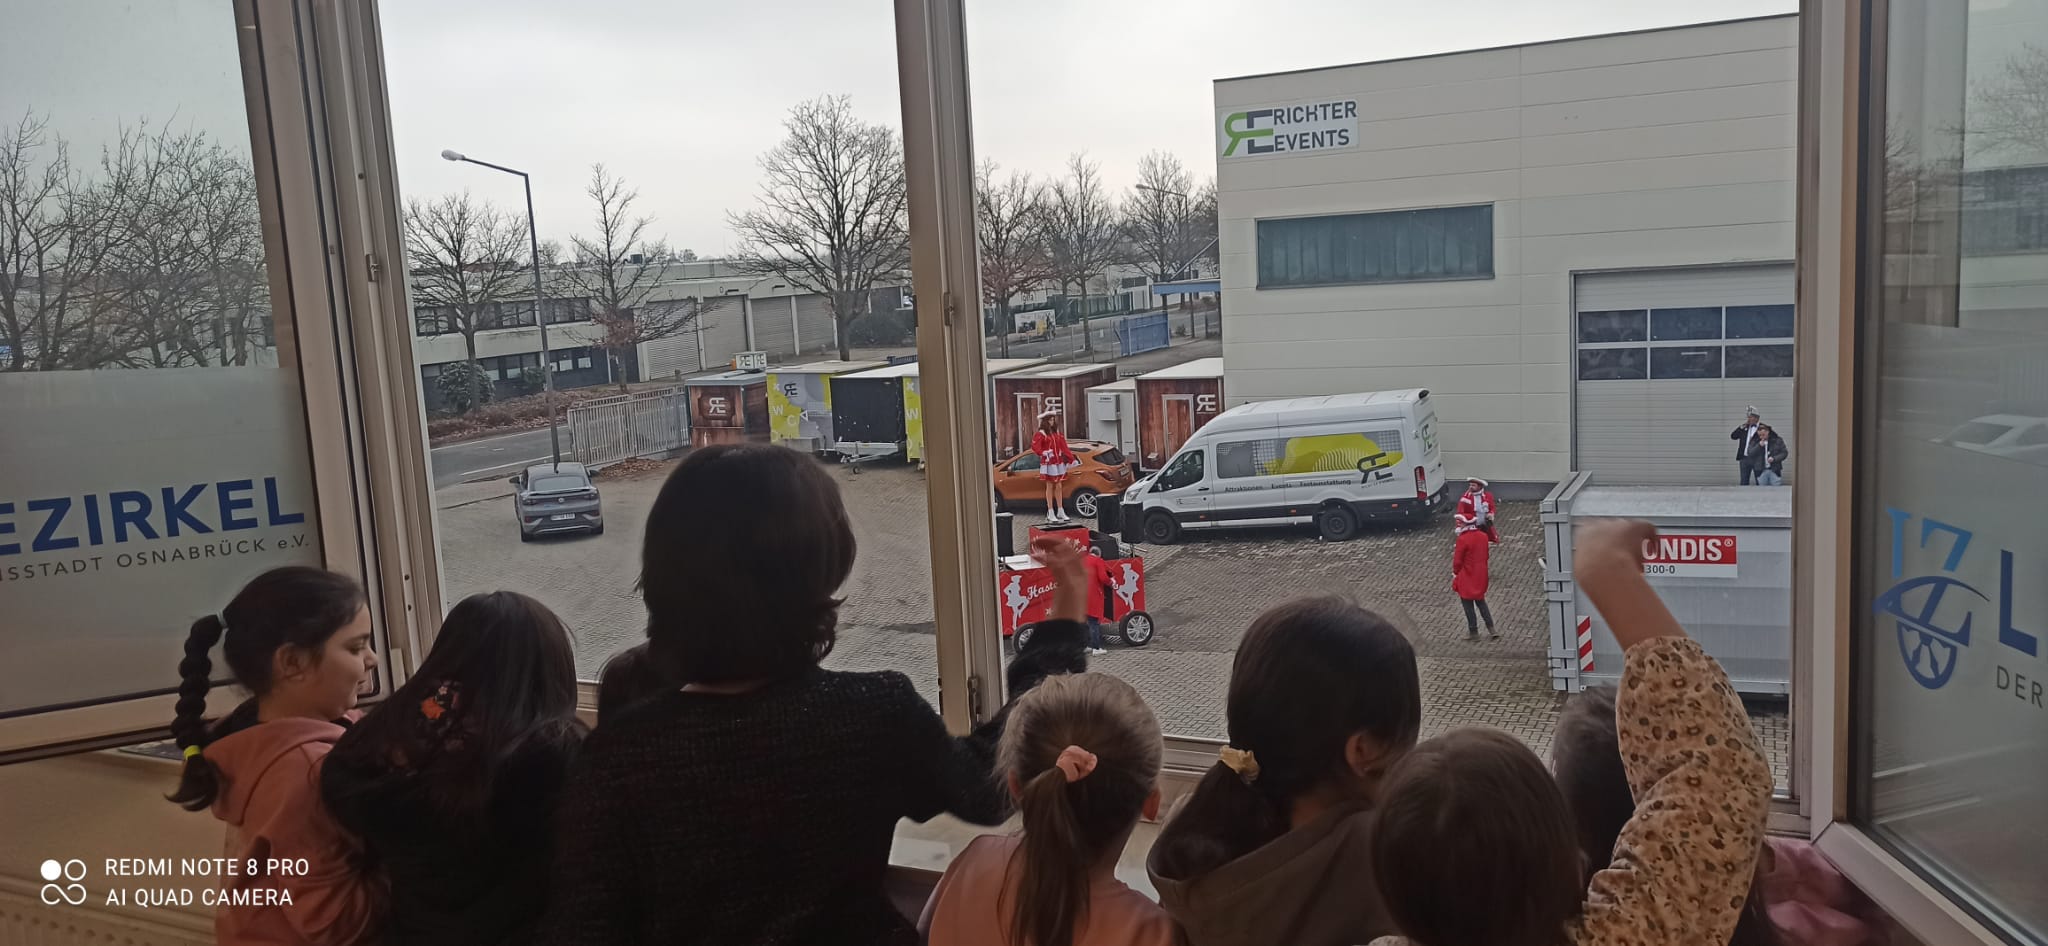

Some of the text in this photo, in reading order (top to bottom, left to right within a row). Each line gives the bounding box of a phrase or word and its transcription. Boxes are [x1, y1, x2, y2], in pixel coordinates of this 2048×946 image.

[1273, 101, 1357, 126] RICHTER
[1274, 129, 1350, 152] EVENTS
[0, 534, 310, 582] SSTADT OSNABRÜCK e.V.
[1996, 665, 2044, 709] DER
